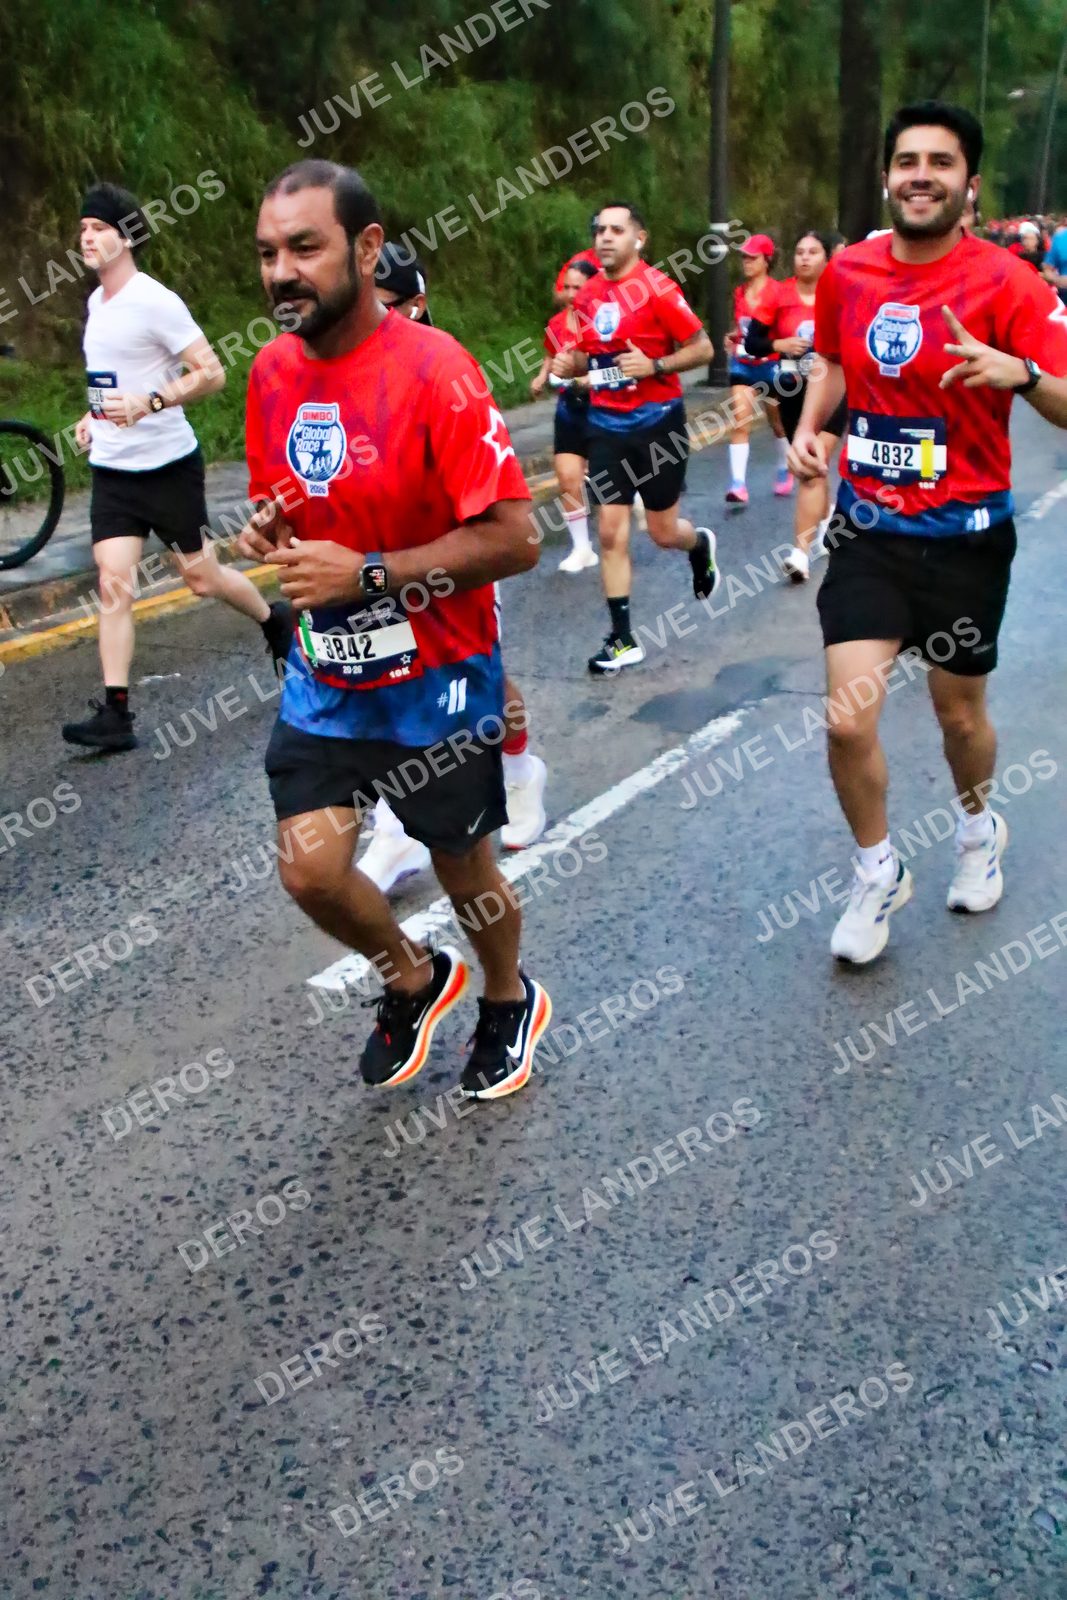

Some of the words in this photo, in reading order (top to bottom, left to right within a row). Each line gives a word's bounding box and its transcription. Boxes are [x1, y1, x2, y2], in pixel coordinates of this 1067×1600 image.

[302, 411, 333, 421] BIMBO
[301, 426, 333, 441] Global
[295, 438, 320, 452] Race
[871, 442, 914, 467] 4832
[322, 634, 376, 661] 3842
[388, 666, 411, 679] 10K
